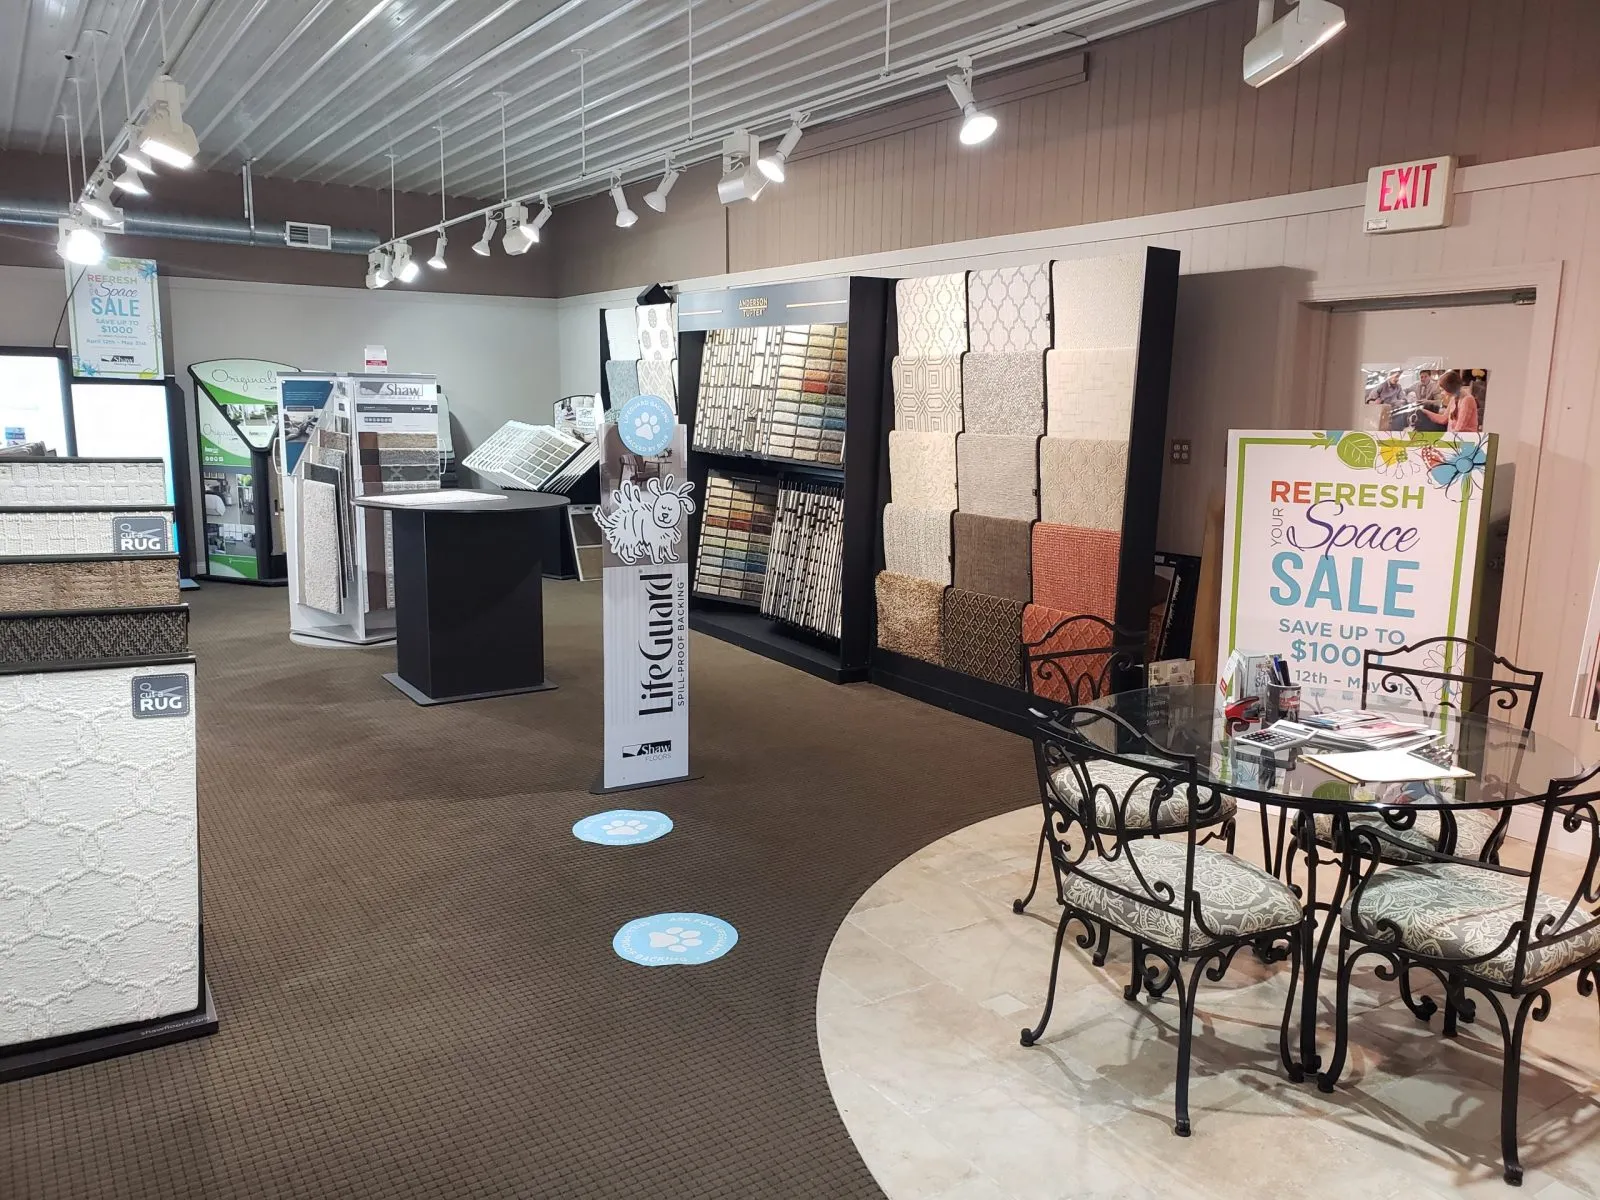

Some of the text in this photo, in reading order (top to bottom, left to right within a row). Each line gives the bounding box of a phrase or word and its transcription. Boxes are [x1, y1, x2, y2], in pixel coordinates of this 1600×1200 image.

[1379, 163, 1438, 212] EXIT
[87, 274, 138, 285] REFRESH
[95, 281, 138, 300] Space
[91, 297, 141, 317] SALE
[739, 297, 768, 307] ANDERSON
[101, 325, 133, 334] $1000
[386, 383, 420, 395] Shaw
[1270, 480, 1425, 510] REFRESH
[1271, 507, 1284, 547] YOUR
[1286, 499, 1421, 560] Space
[121, 538, 161, 550] RUG
[1269, 551, 1420, 618] SALE
[1279, 618, 1406, 646] SAVE UP TO
[638, 573, 674, 716] LifeGuard
[677, 635, 685, 707] SPILL-PROOF
[1296, 669, 1328, 685] 12th
[140, 691, 155, 699] cut
[140, 696, 182, 712] RUG
[641, 741, 671, 755] Shaw
[645, 753, 672, 762] FLOORS
